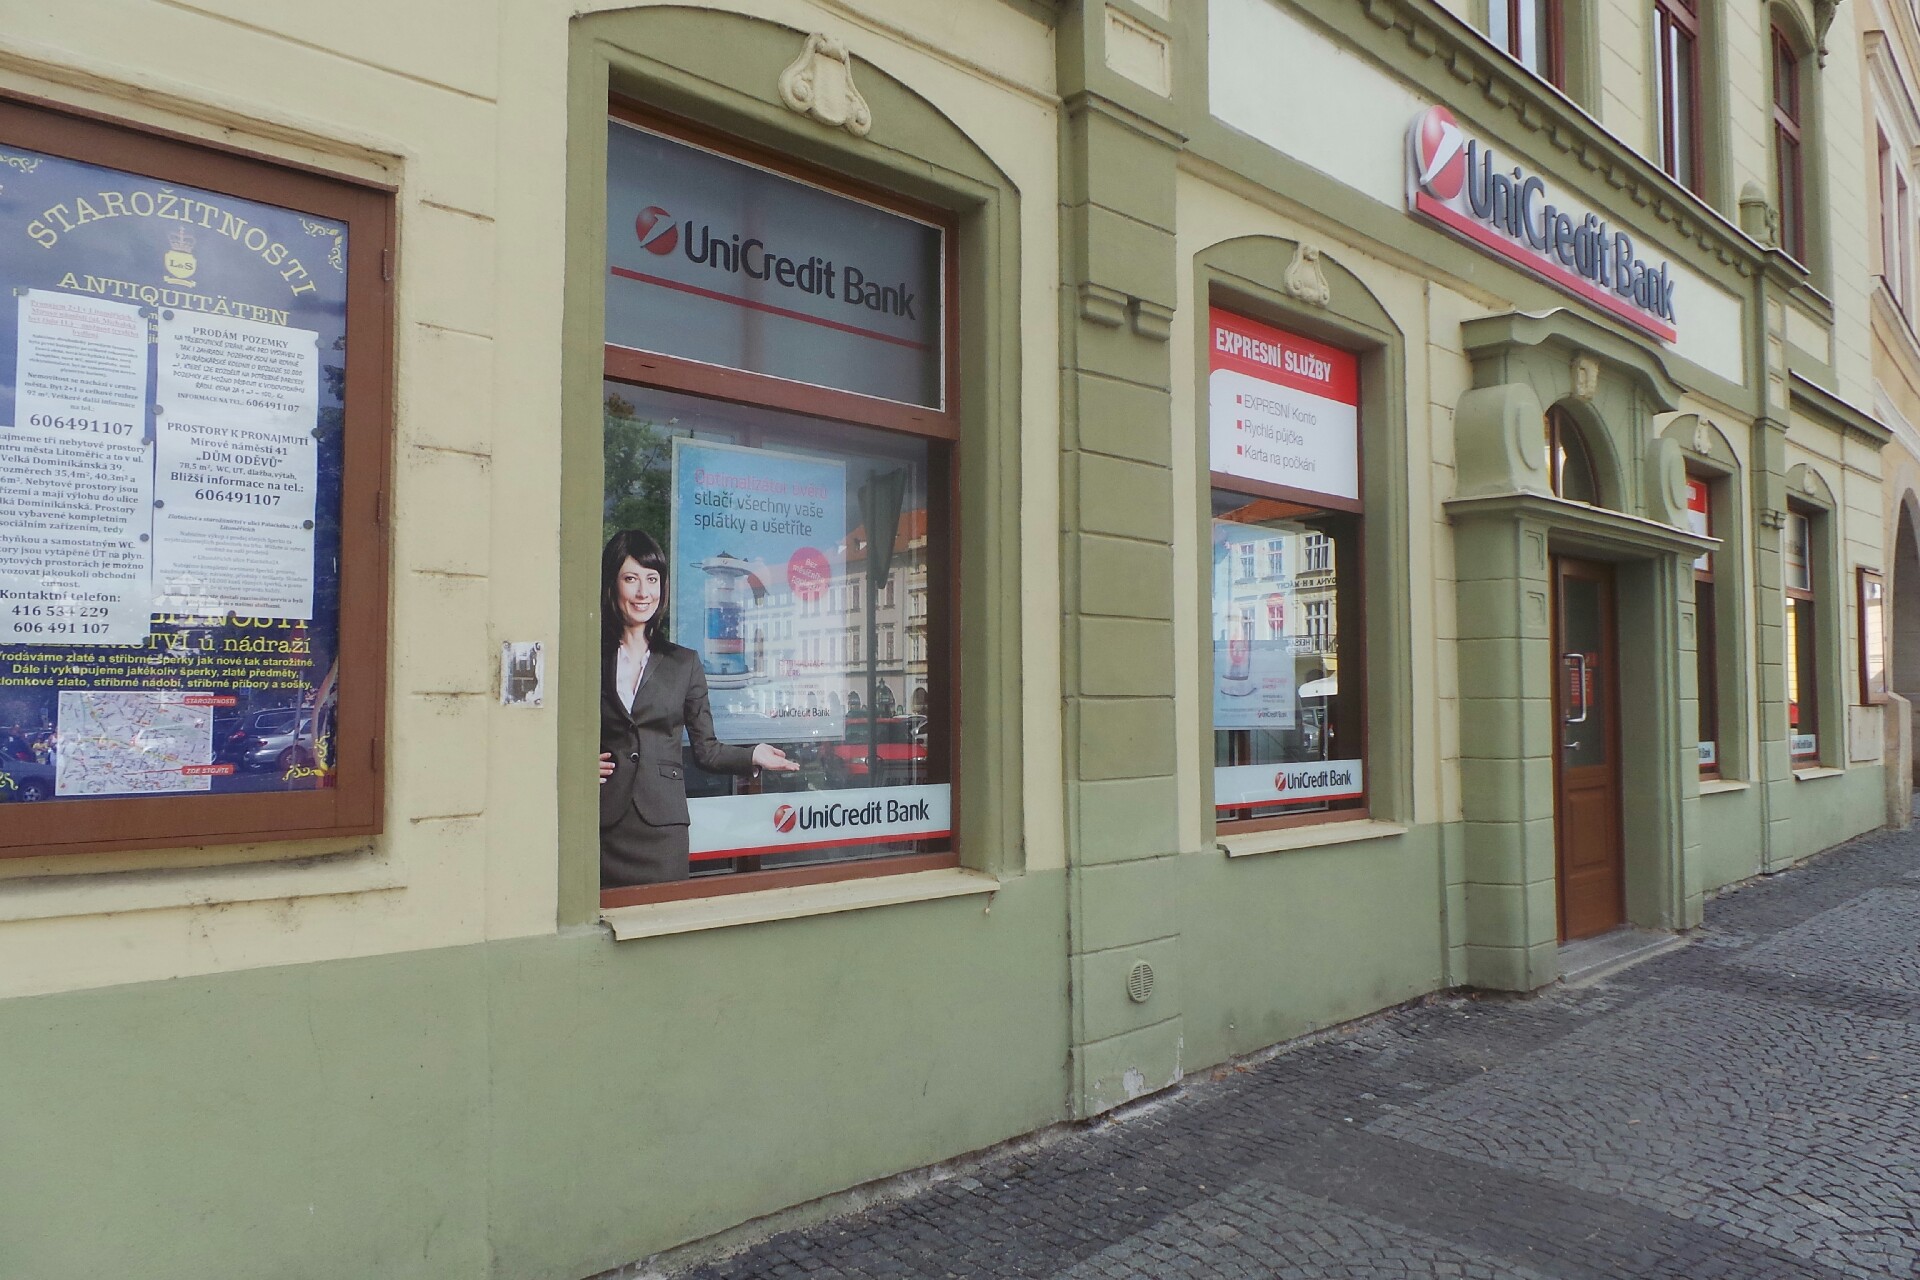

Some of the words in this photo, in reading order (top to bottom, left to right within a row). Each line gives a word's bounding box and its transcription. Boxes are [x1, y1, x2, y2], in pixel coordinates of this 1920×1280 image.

[1468, 139, 1611, 288] UniCredit
[1615, 231, 1677, 325] Bank
[27, 187, 317, 297] STAROŽITNOSTI
[685, 220, 835, 298] UniCredit
[844, 266, 916, 320] Bank
[57, 272, 289, 327] ANTIQUITÄTEN
[192, 326, 238, 341] PRODÁM
[242, 335, 289, 349] POZEMKY
[1216, 327, 1281, 368] EXPRESNÍ
[1285, 351, 1332, 382] SLUŽBY
[246, 399, 300, 413] 606491107
[1244, 394, 1290, 419] EXPRESNÍ
[1292, 407, 1316, 425] Konto
[30, 413, 133, 436] 606491107
[1244, 420, 1274, 439] Rychlá
[1276, 430, 1303, 446] půjčka
[167, 422, 229, 437] PROSTORY
[231, 430, 239, 438] K
[241, 431, 309, 446] PRONAJMUTÍ
[24, 446, 54, 455] města
[56, 448, 104, 460] Litoměřic
[59, 439, 104, 450] nebytové
[107, 445, 146, 455] prostory
[191, 437, 229, 449] Mírové
[232, 441, 273, 454] náměstí
[275, 447, 288, 455] 41
[1, 454, 30, 464] Velká
[33, 456, 108, 470] Dominikánská
[1244, 446, 1268, 463] Karta
[1271, 453, 1281, 465] na
[26, 477, 73, 488] Nebytové
[75, 483, 117, 494] prostory
[119, 484, 139, 494] jsou
[170, 471, 204, 483] Bližší
[207, 474, 265, 488] informace
[267, 482, 281, 491] na
[102, 494, 114, 502] do
[116, 496, 139, 504] ulice
[195, 489, 281, 506] 606491107
[694, 490, 734, 509] stlačí
[737, 494, 791, 518] všechny
[794, 502, 824, 519] vaše
[17, 498, 93, 511] Dominikánská.
[95, 504, 136, 515] Prostory
[18, 509, 66, 519] vybavené
[68, 511, 127, 523] kompletním
[694, 512, 746, 534] splátky
[750, 519, 758, 532] a
[762, 517, 813, 537] ušetříte
[103, 526, 124, 535] tedy
[21, 546, 42, 555] jsou
[51, 538, 116, 548] samostatným
[45, 558, 99, 568] prostorách
[101, 561, 111, 569] je
[113, 561, 144, 570] možno
[42, 569, 90, 578] jakoukoli
[92, 570, 136, 580] obchodní
[0, 589, 67, 601] Kontaktní
[71, 591, 121, 602] telefon:
[11, 605, 42, 616] 416
[80, 607, 109, 618] 229
[13, 621, 43, 633] 606
[47, 623, 76, 634] 491
[82, 623, 110, 634] 107
[224, 636, 311, 654] nádraží
[0, 651, 63, 661] rodáváme
[66, 652, 95, 662] zlaté
[99, 655, 106, 663] a
[109, 653, 152, 665] stříbrné
[197, 656, 214, 666] jak
[217, 656, 242, 666] nové
[244, 657, 260, 666] tak
[262, 656, 315, 667] starožitné.
[12, 664, 40, 674] Dále
[43, 664, 48, 674] i
[126, 666, 176, 677] jakékoliv
[179, 668, 220, 678] šperky,
[222, 667, 246, 677] zlaté
[249, 668, 299, 679] předměty,
[0, 676, 54, 686] lomkové
[57, 677, 90, 688] zlato,
[93, 677, 139, 687] stříbrné
[187, 679, 229, 689] stříbrné
[232, 679, 269, 690] příbory
[1287, 770, 1328, 790] UniCredit
[1330, 768, 1352, 787] Bank
[800, 800, 882, 829] UniCredit
[887, 798, 929, 823] Bank
